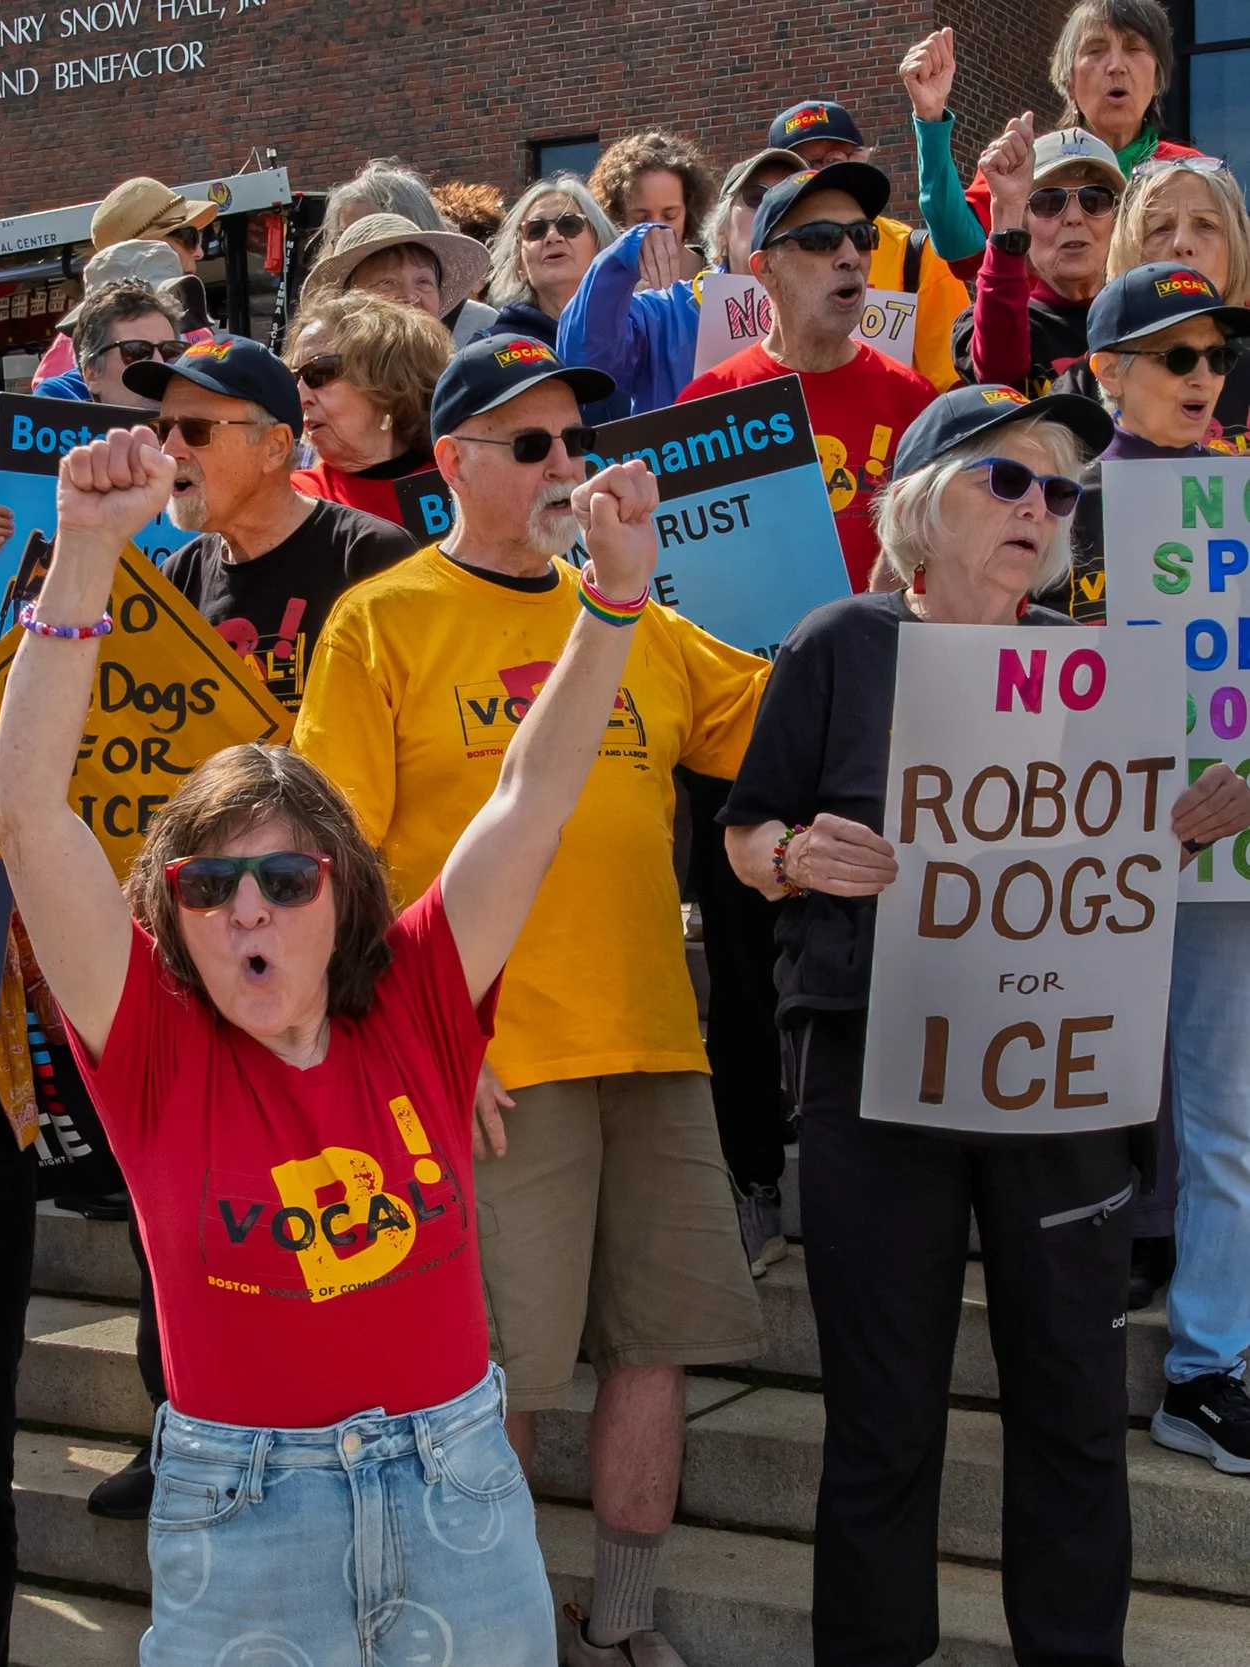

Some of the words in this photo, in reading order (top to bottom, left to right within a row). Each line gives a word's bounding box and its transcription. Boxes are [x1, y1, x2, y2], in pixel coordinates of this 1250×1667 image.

[60, 0, 141, 38] SNOW
[54, 40, 205, 91] BENEFACTOR
[2, 220, 14, 229] BAY
[17, 233, 57, 250] CENTER
[274, 281, 285, 315] EMMA
[12, 414, 107, 455] Bost
[584, 411, 795, 482] namics
[651, 494, 751, 549] RUST
[1181, 475, 1250, 529] N
[107, 593, 158, 634] O
[100, 661, 220, 734] Dogs
[995, 648, 1106, 714] NO
[466, 747, 504, 760] BOSTON
[604, 749, 622, 758] AND
[623, 749, 648, 759] LABOR
[899, 756, 1176, 844] ROBOT
[917, 853, 1162, 941] DOGS
[998, 972, 1065, 995] FOR
[918, 1014, 1114, 1111] ICE
[217, 1181, 446, 1251] VOCAL
[207, 1275, 260, 1295] BOSTON
[318, 1286, 335, 1297] OF
